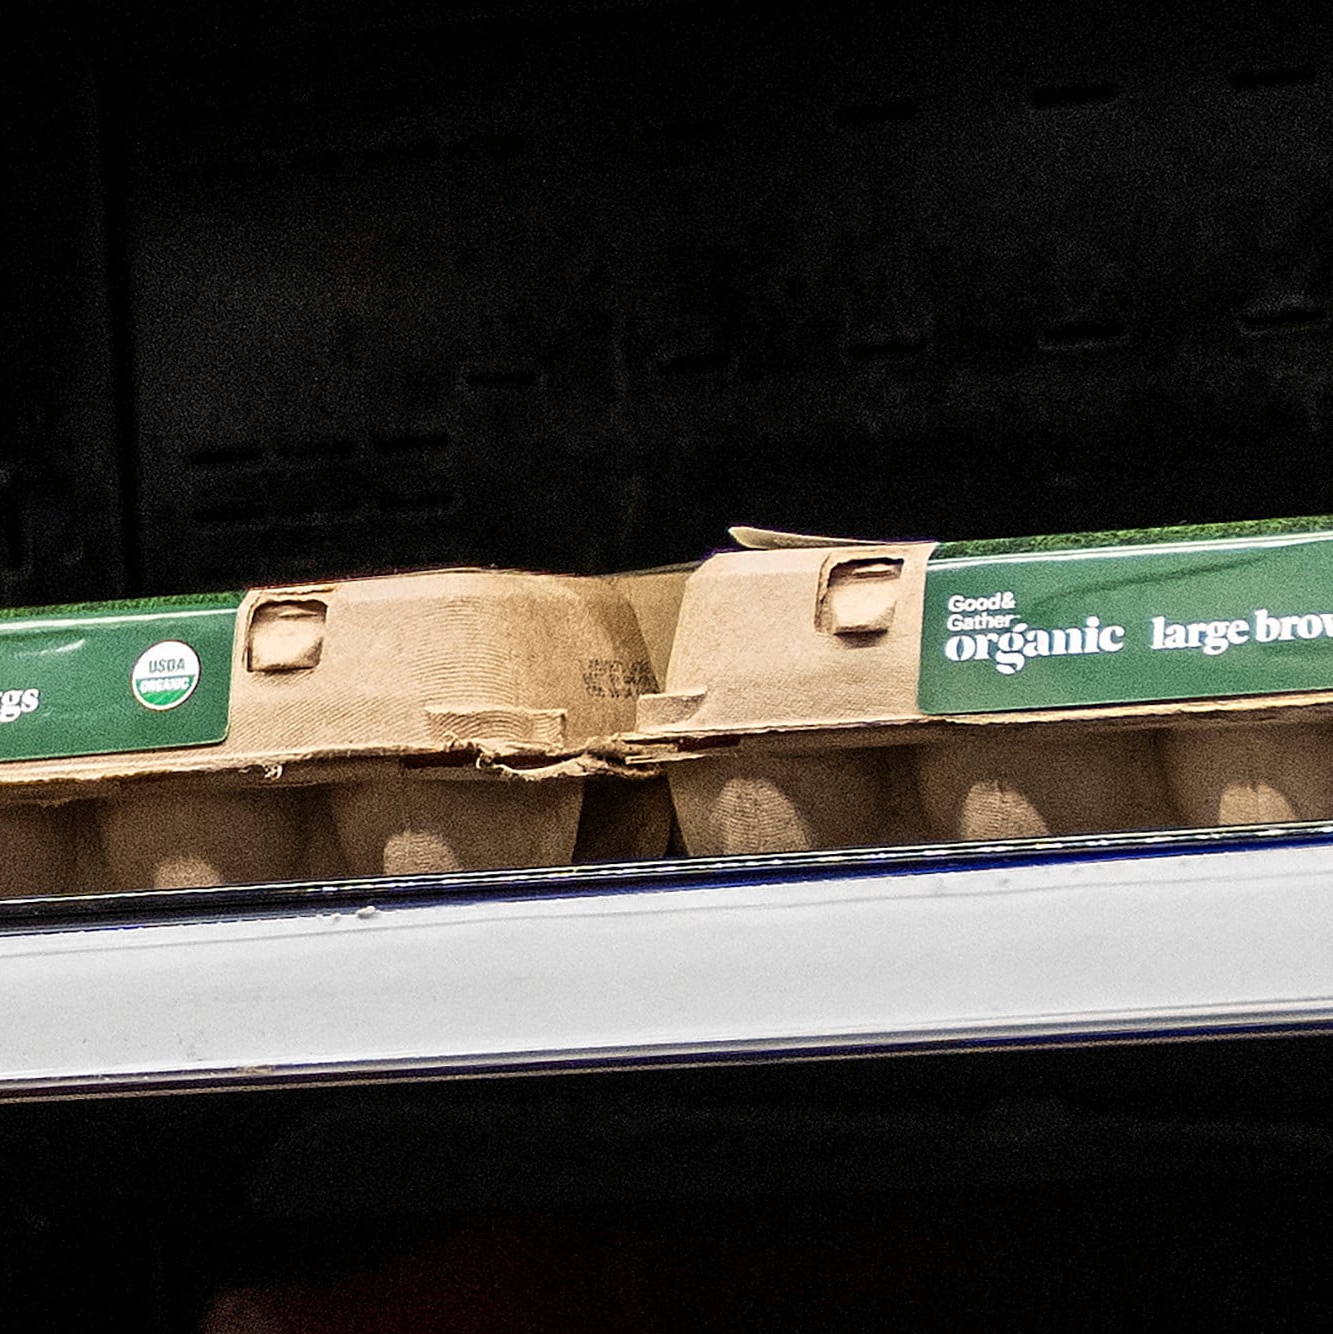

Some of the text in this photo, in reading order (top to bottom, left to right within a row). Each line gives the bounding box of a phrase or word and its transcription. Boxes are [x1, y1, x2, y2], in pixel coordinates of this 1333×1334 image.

[948, 591, 1017, 612] Good&
[947, 612, 1014, 631] Gather
[944, 616, 1126, 675] organic
[1150, 615, 1250, 656] large
